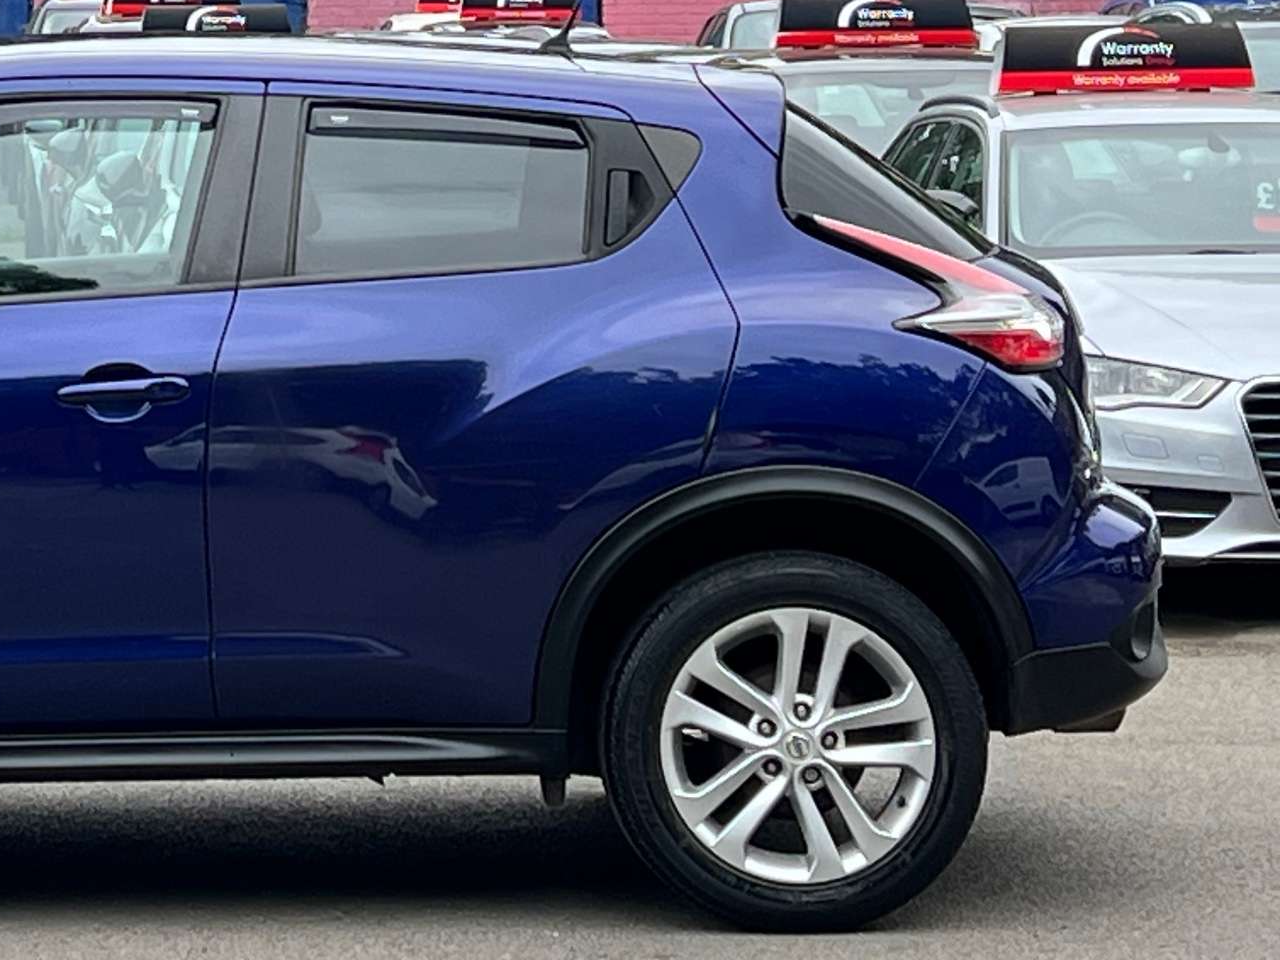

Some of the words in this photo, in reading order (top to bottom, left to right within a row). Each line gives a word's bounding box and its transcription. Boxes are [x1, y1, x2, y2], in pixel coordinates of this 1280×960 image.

[1100, 41, 1174, 58] Warranty
[1101, 56, 1143, 67] Solutions
[1072, 73, 1126, 87] Warranty
[1127, 73, 1180, 85] available
